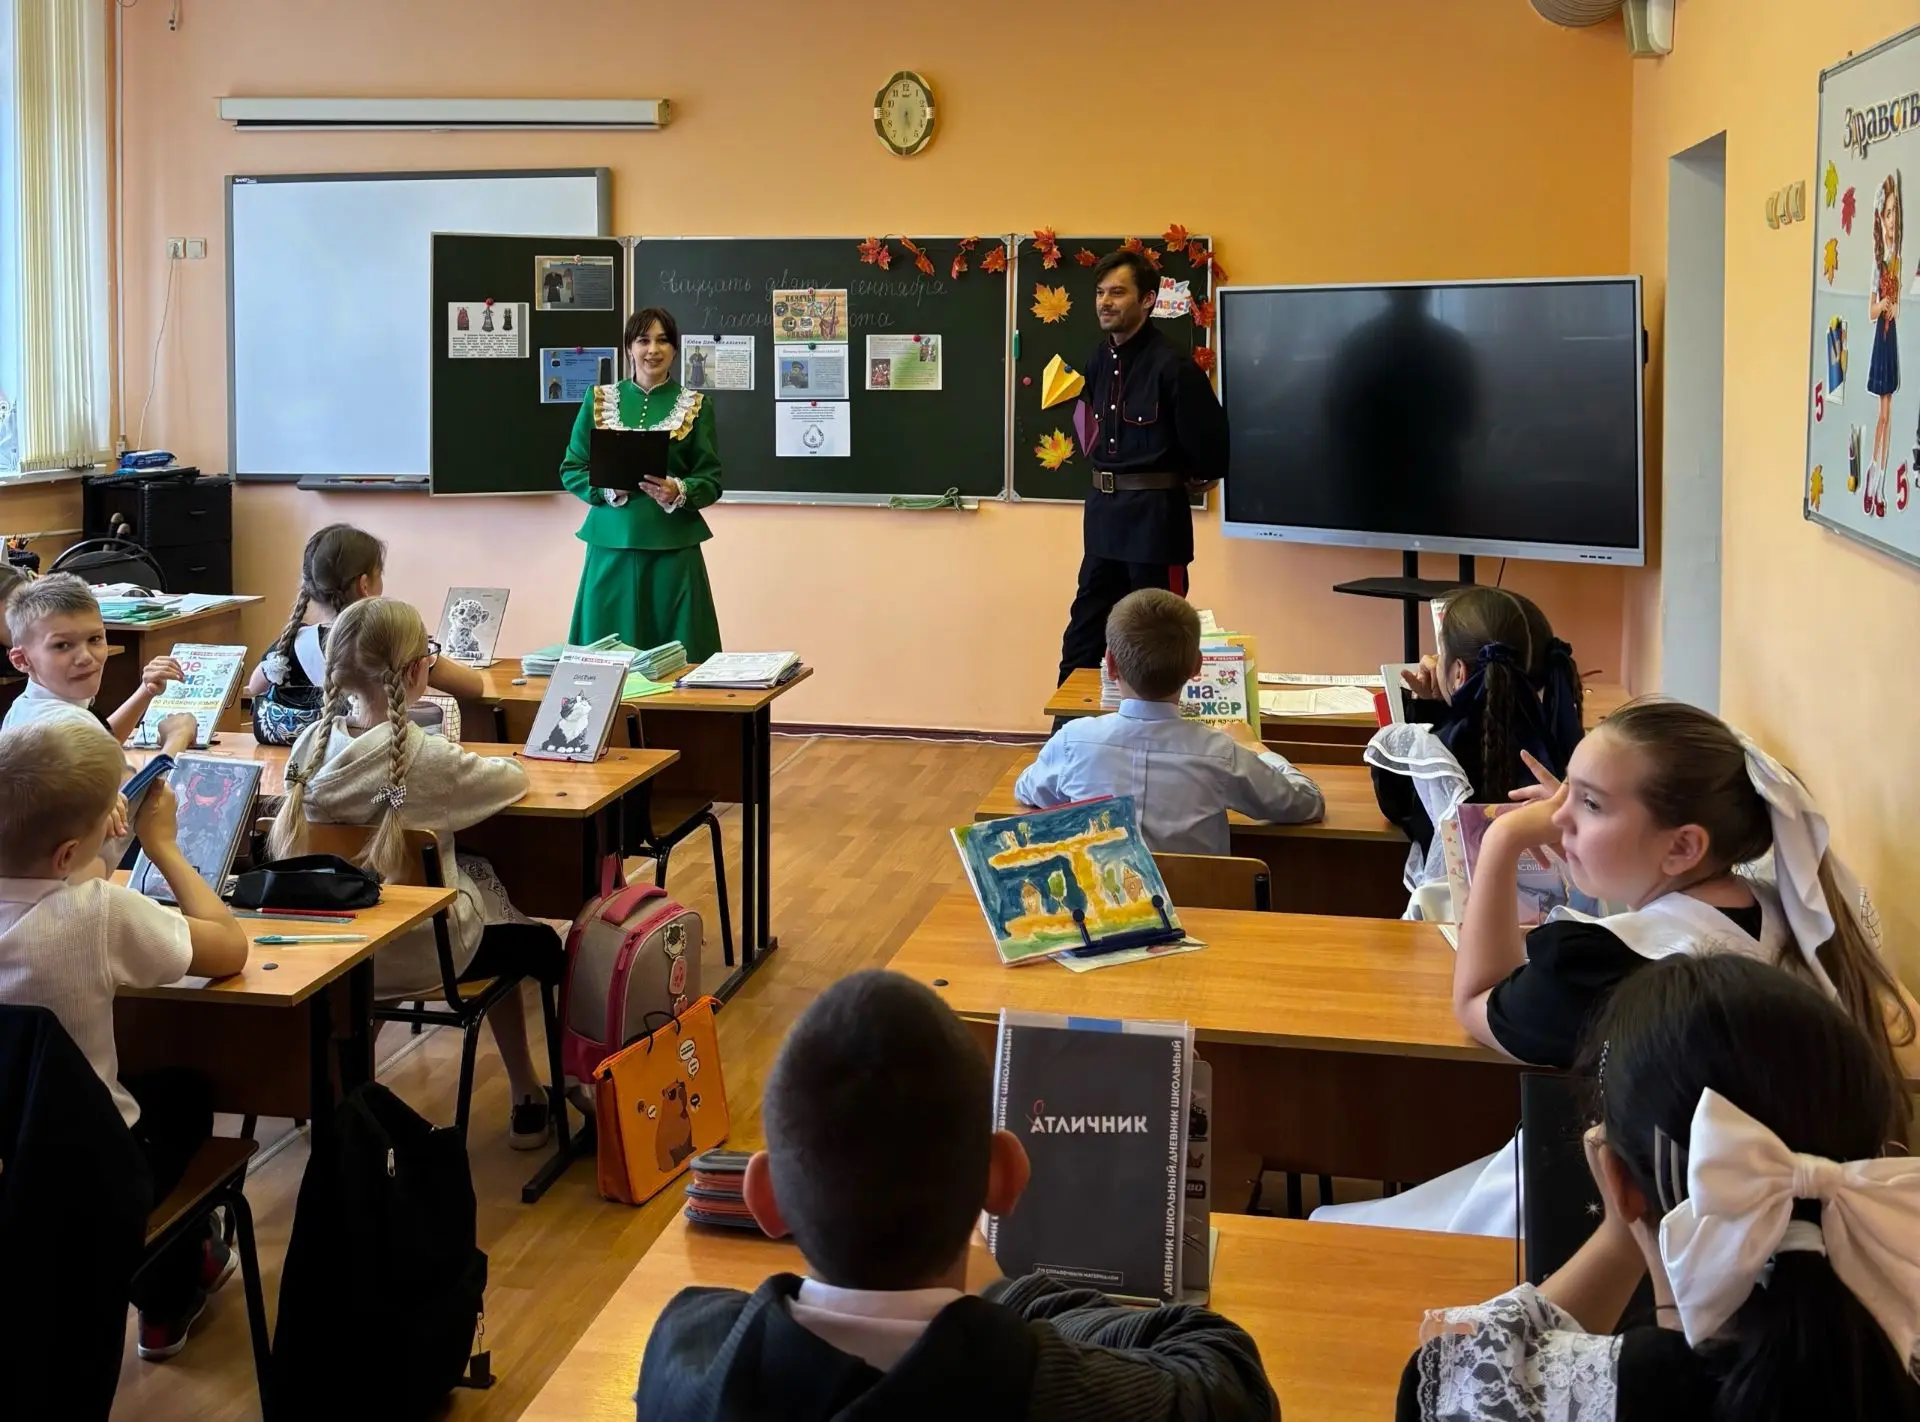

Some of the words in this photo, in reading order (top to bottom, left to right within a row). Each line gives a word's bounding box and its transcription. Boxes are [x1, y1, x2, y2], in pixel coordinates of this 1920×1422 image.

[848, 272, 952, 308] сентября
[1156, 299, 1190, 312] ласс!
[1814, 382, 1824, 422] 5
[1896, 463, 1909, 511] 5
[1200, 696, 1242, 715] жёр
[1030, 1115, 1149, 1133] АТЛИЧНИК
[1163, 1239, 1175, 1296] ДНЕВНИК
[1170, 1040, 1183, 1108] ШКОЛЬНЫЙ
